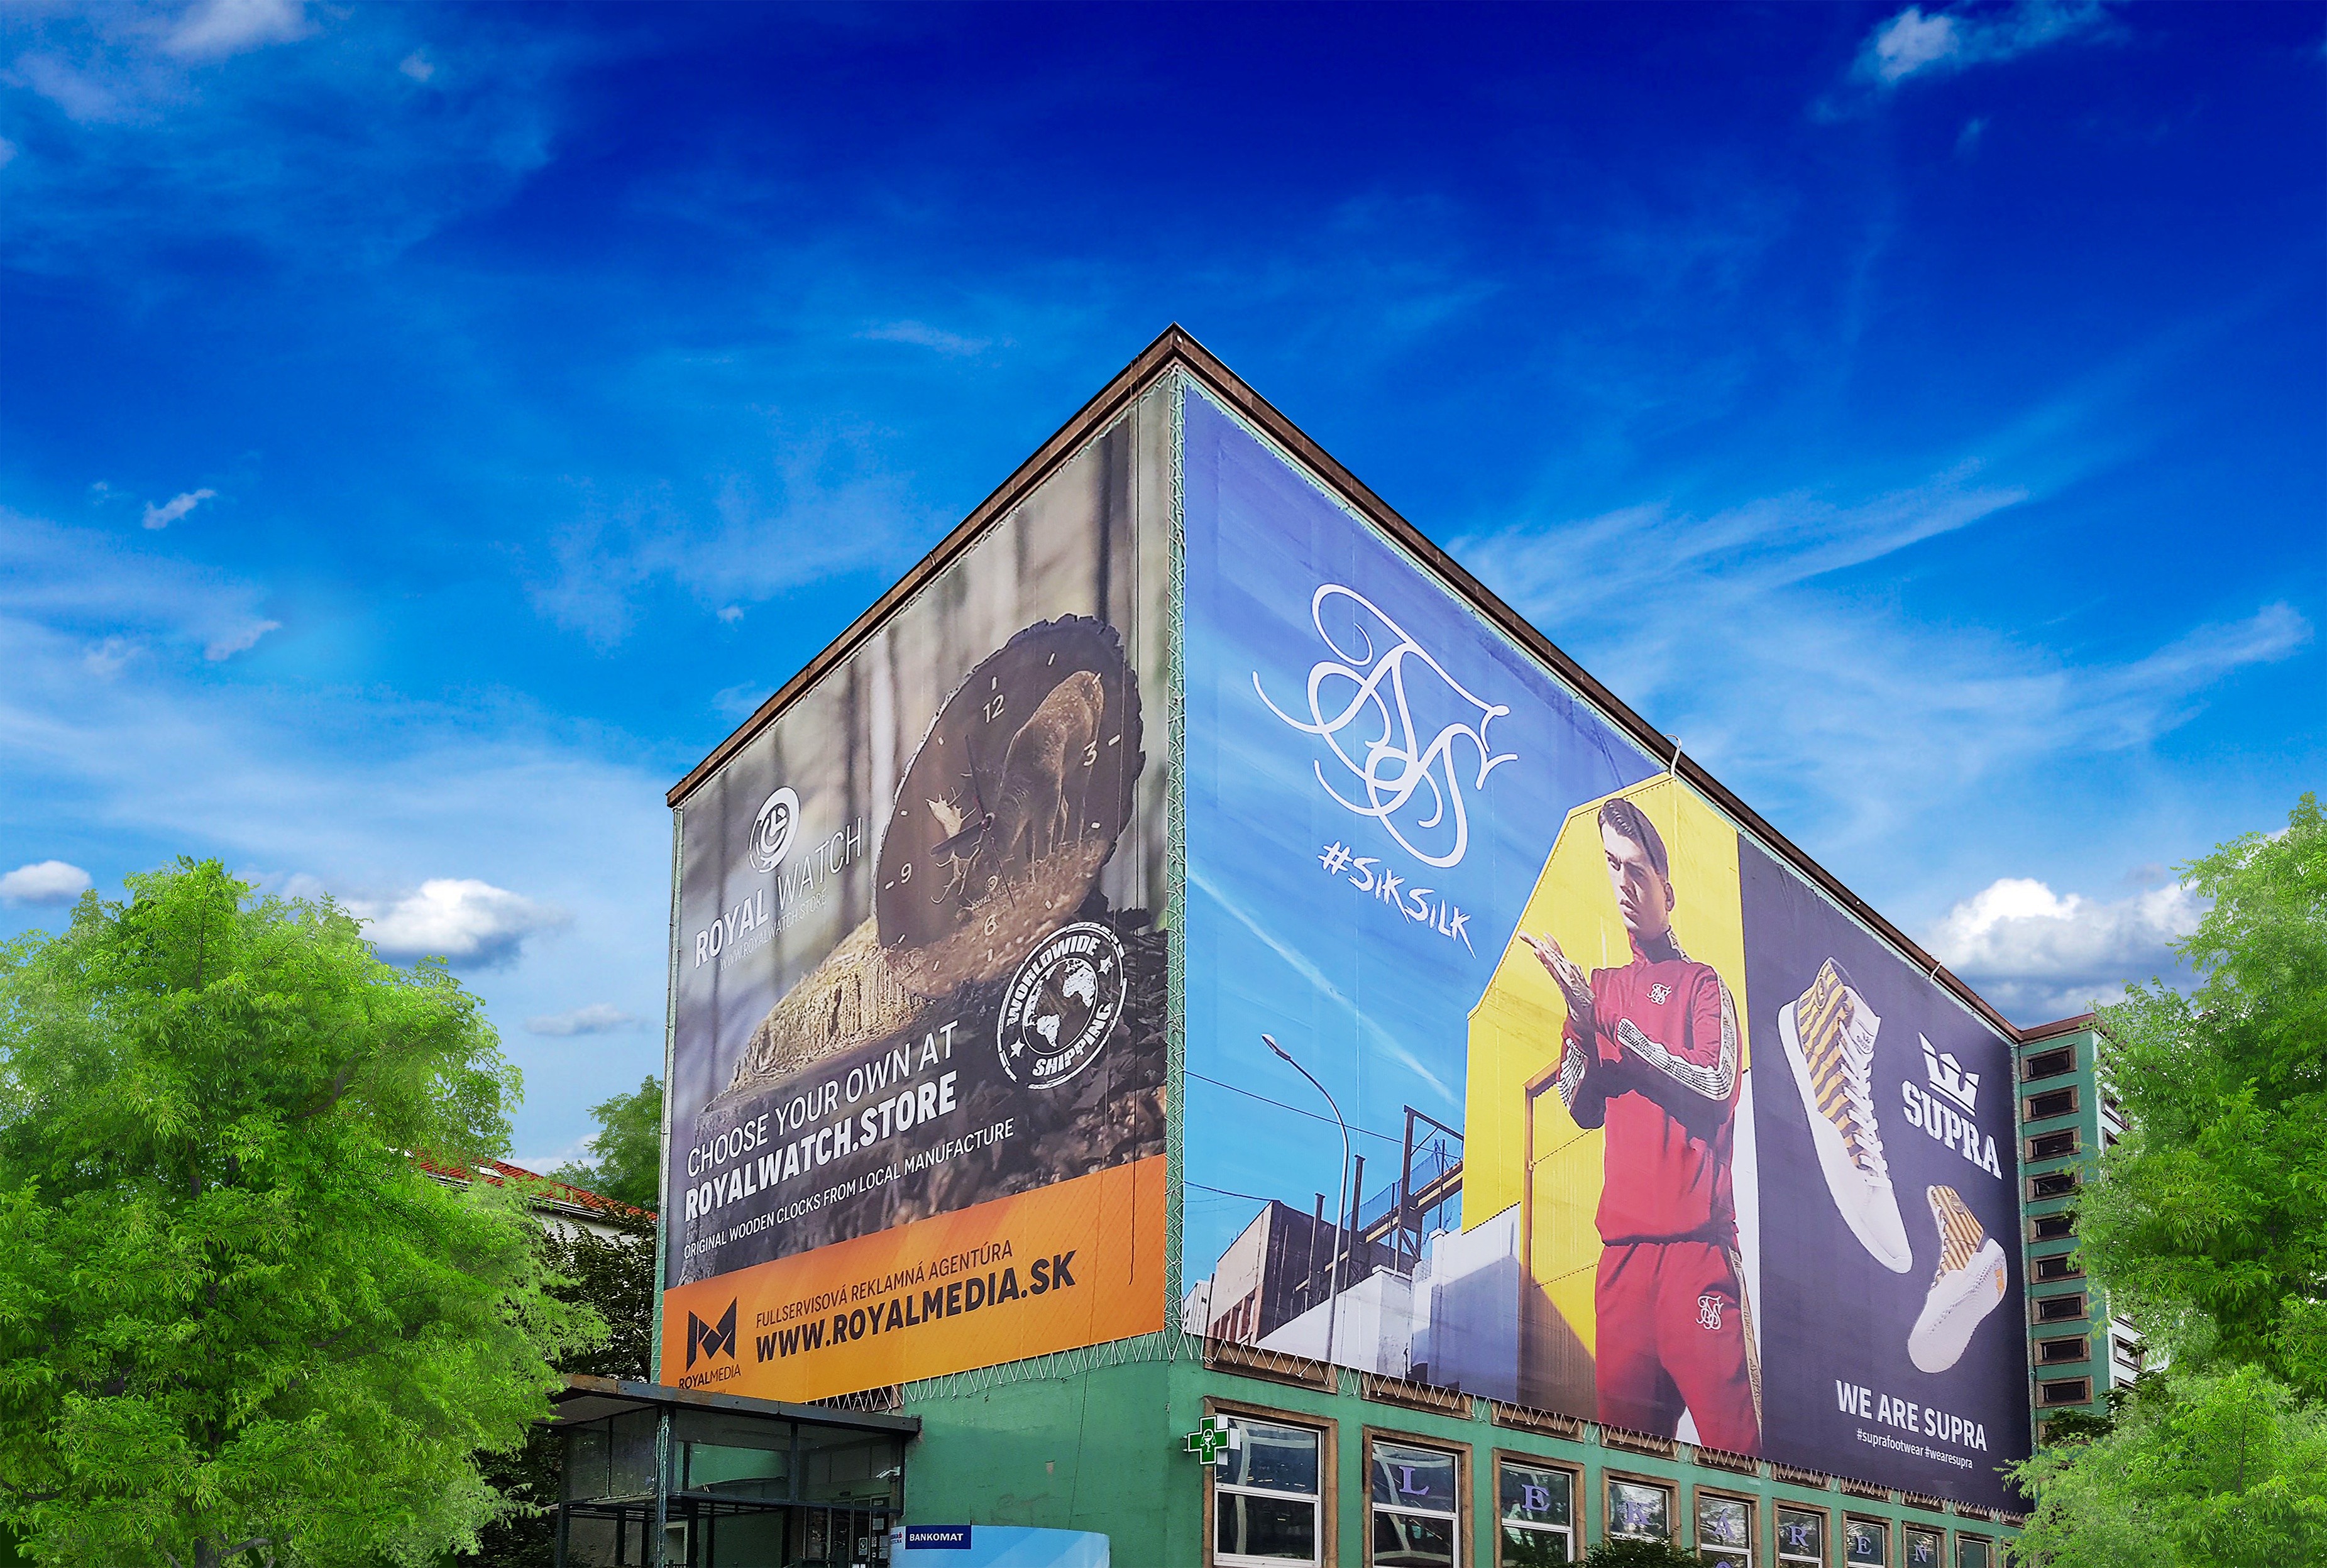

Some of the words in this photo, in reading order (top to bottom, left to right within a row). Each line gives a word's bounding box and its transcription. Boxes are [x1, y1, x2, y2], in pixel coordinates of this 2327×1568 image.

[695, 888, 769, 969] ROYAL
[777, 816, 864, 911] WATCH
[1006, 935, 1101, 1026] WORLDWIDE
[1032, 1002, 1114, 1077] SHIPPING
[687, 1113, 769, 1178] CHOOSE
[774, 1080, 839, 1136] YOUR
[845, 1049, 910, 1104] OWN
[917, 1020, 959, 1071] AT
[1901, 1080, 2003, 1180] SUPRA
[684, 1070, 958, 1222] ROYALWATCH.STORE
[684, 1229, 727, 1259] ORIGINAL
[729, 1214, 774, 1242] WOODEN
[776, 1193, 821, 1223] CLOCKS
[823, 1182, 857, 1207] FROM
[859, 1166, 901, 1194] LOCAL
[903, 1117, 1015, 1175] MANUFACTURE
[756, 1283, 848, 1329] FULLSERVISOVÁ
[850, 1261, 925, 1302] REKLAMNÁ
[928, 1239, 1013, 1280] AGENTÚRA
[756, 1249, 1077, 1364] WWW.ROYALMEDIA.SK
[679, 1364, 742, 1390] ROYALMEDIA
[1836, 1379, 1873, 1420] WE
[1878, 1393, 1919, 1433] ARE
[1924, 1408, 1988, 1452] SUPRA
[1856, 1427, 1924, 1457] #suprafootwear
[1925, 1445, 1973, 1469] #wearesupra
[909, 1532, 964, 1542] BANKOMAT
